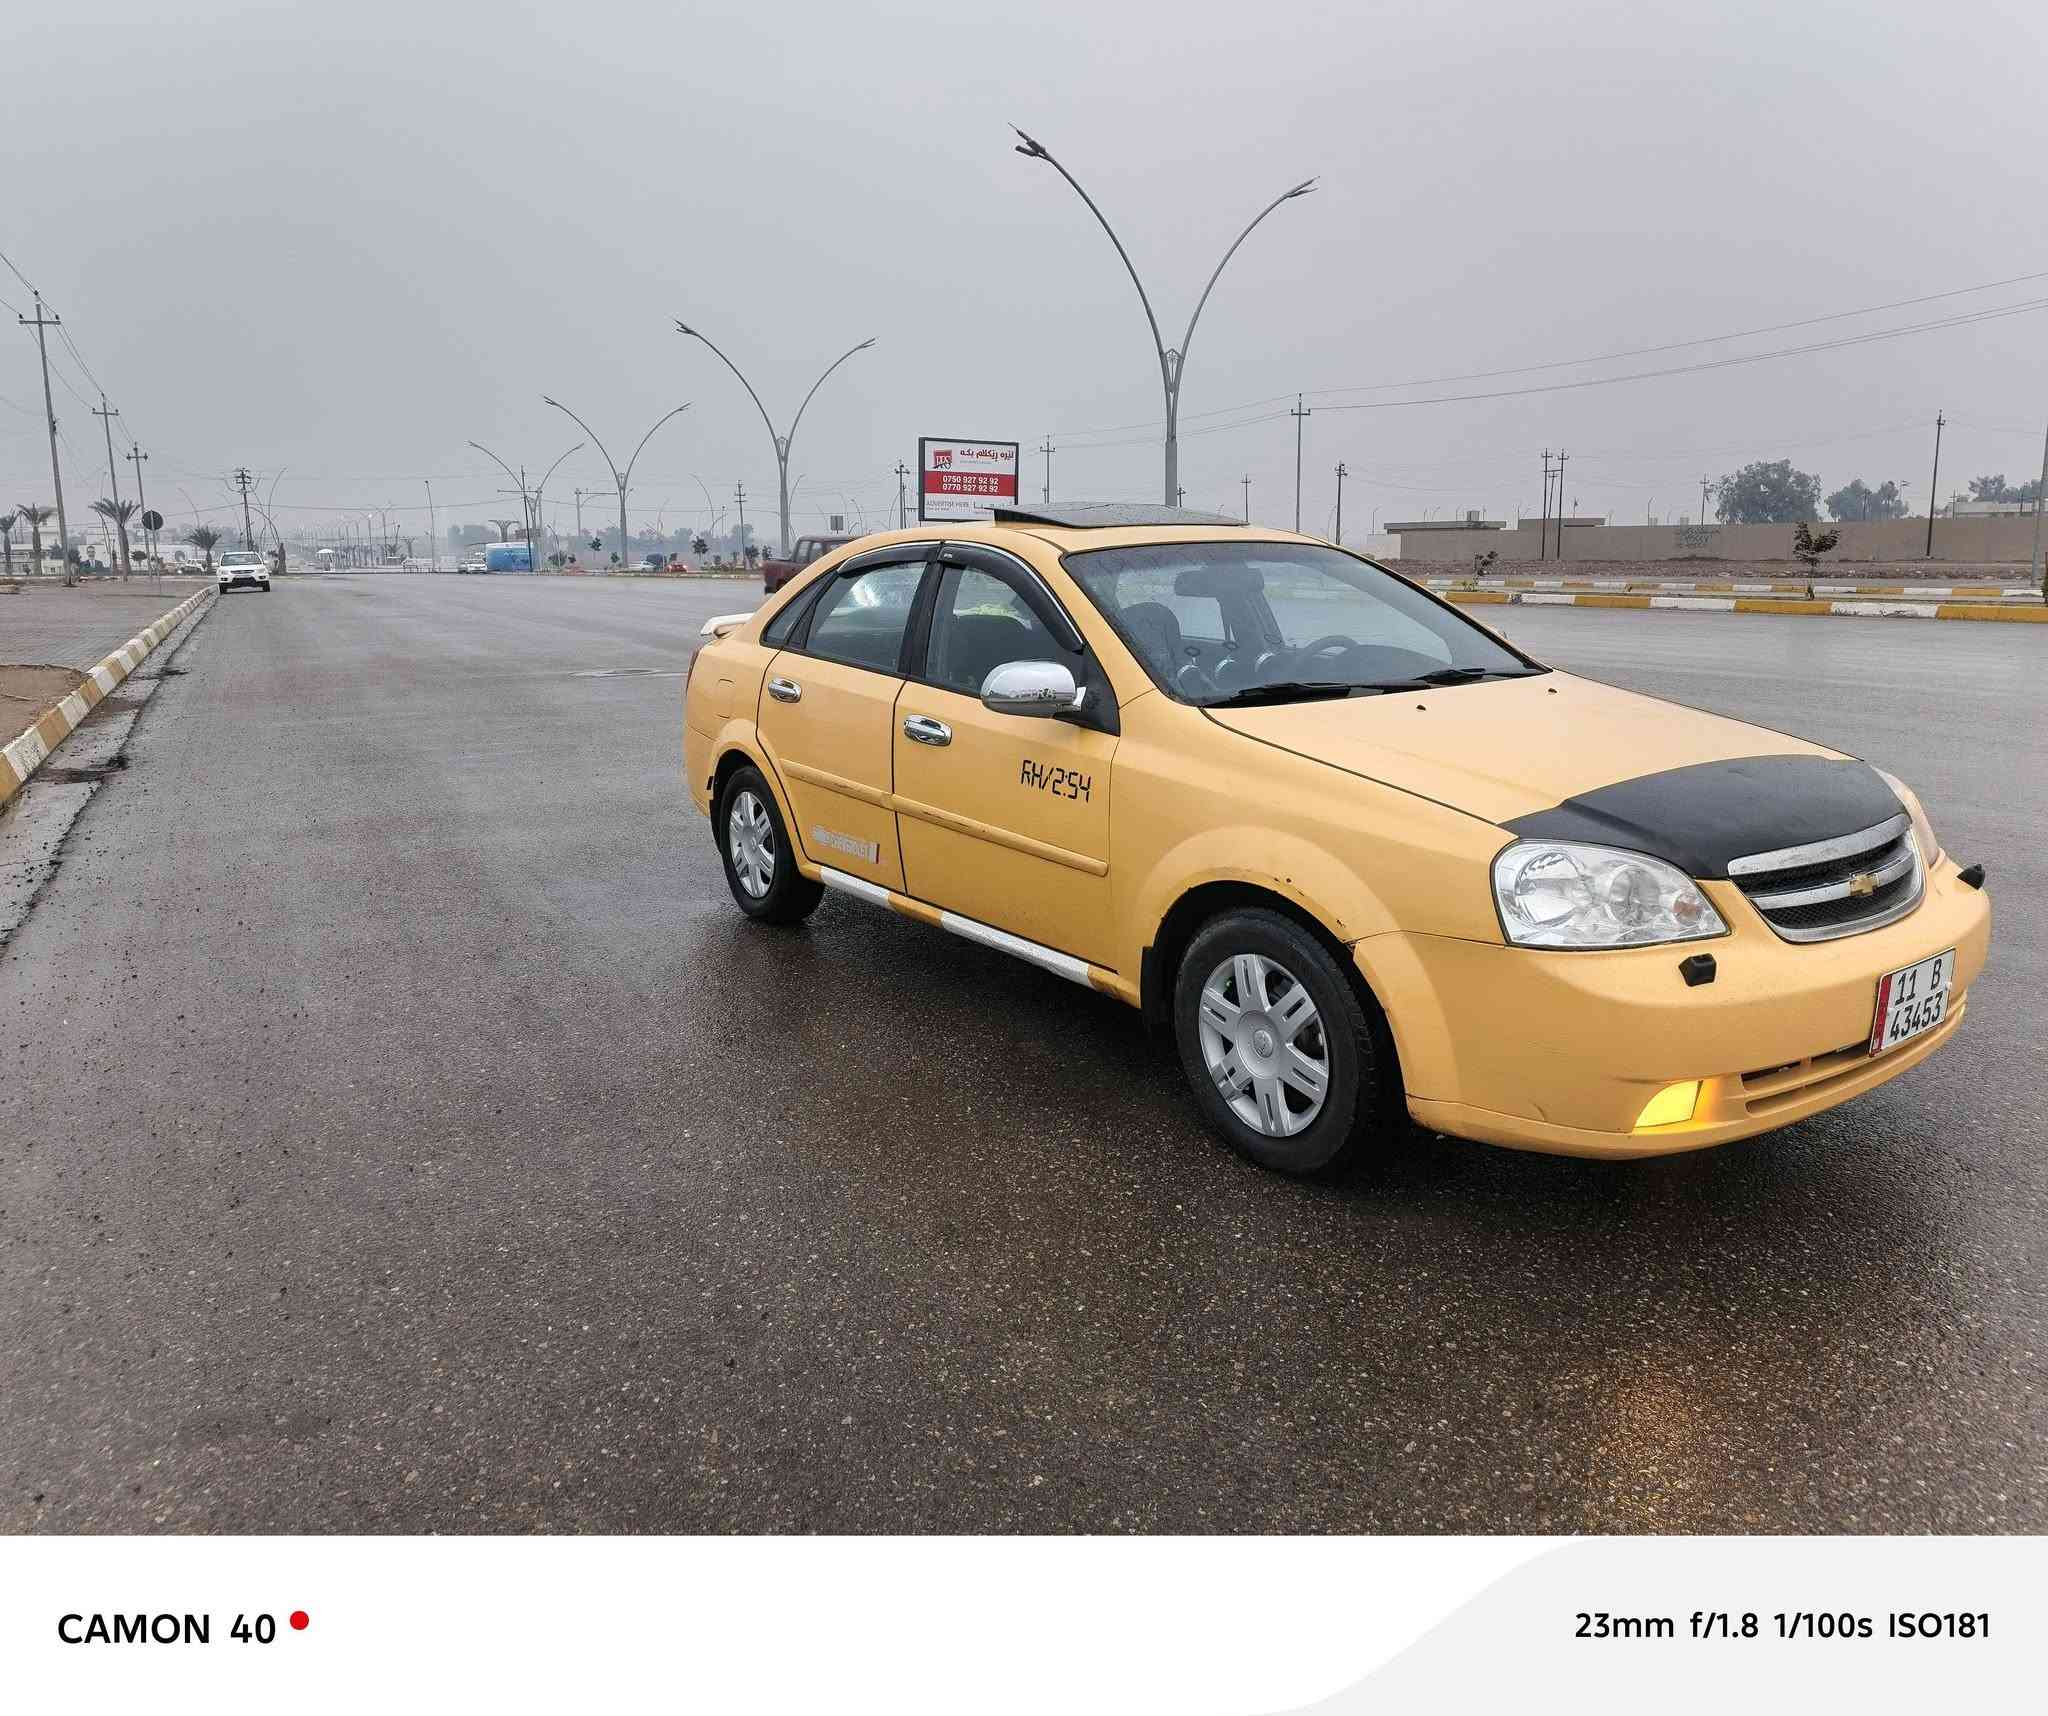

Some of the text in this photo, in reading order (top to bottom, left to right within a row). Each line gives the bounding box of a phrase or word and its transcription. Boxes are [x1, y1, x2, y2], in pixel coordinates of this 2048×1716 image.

[942, 483, 961, 491] 0770
[963, 484, 976, 492] 927
[988, 485, 999, 493] 92
[963, 476, 976, 484] 927
[978, 477, 988, 485] 92
[988, 478, 999, 486] 92
[1895, 958, 1942, 1005] 11 B
[1889, 990, 1944, 1041] 43453
